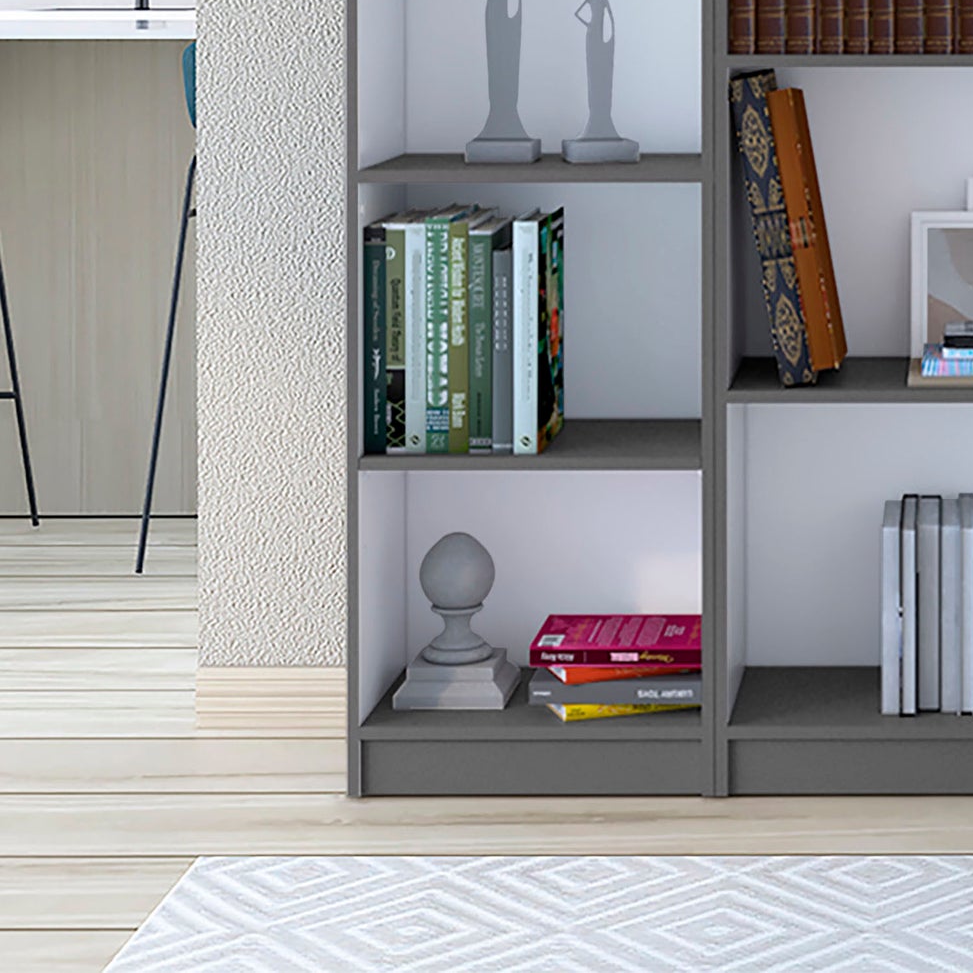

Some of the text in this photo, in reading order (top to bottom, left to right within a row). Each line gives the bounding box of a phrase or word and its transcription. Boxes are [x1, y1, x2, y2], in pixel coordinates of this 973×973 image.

[427, 231, 448, 318] PRACTICAL
[390, 278, 401, 362] Quantum Field Theory of
[427, 322, 448, 406] NOMAD
[638, 690, 693, 698] LUXURY TOYS
